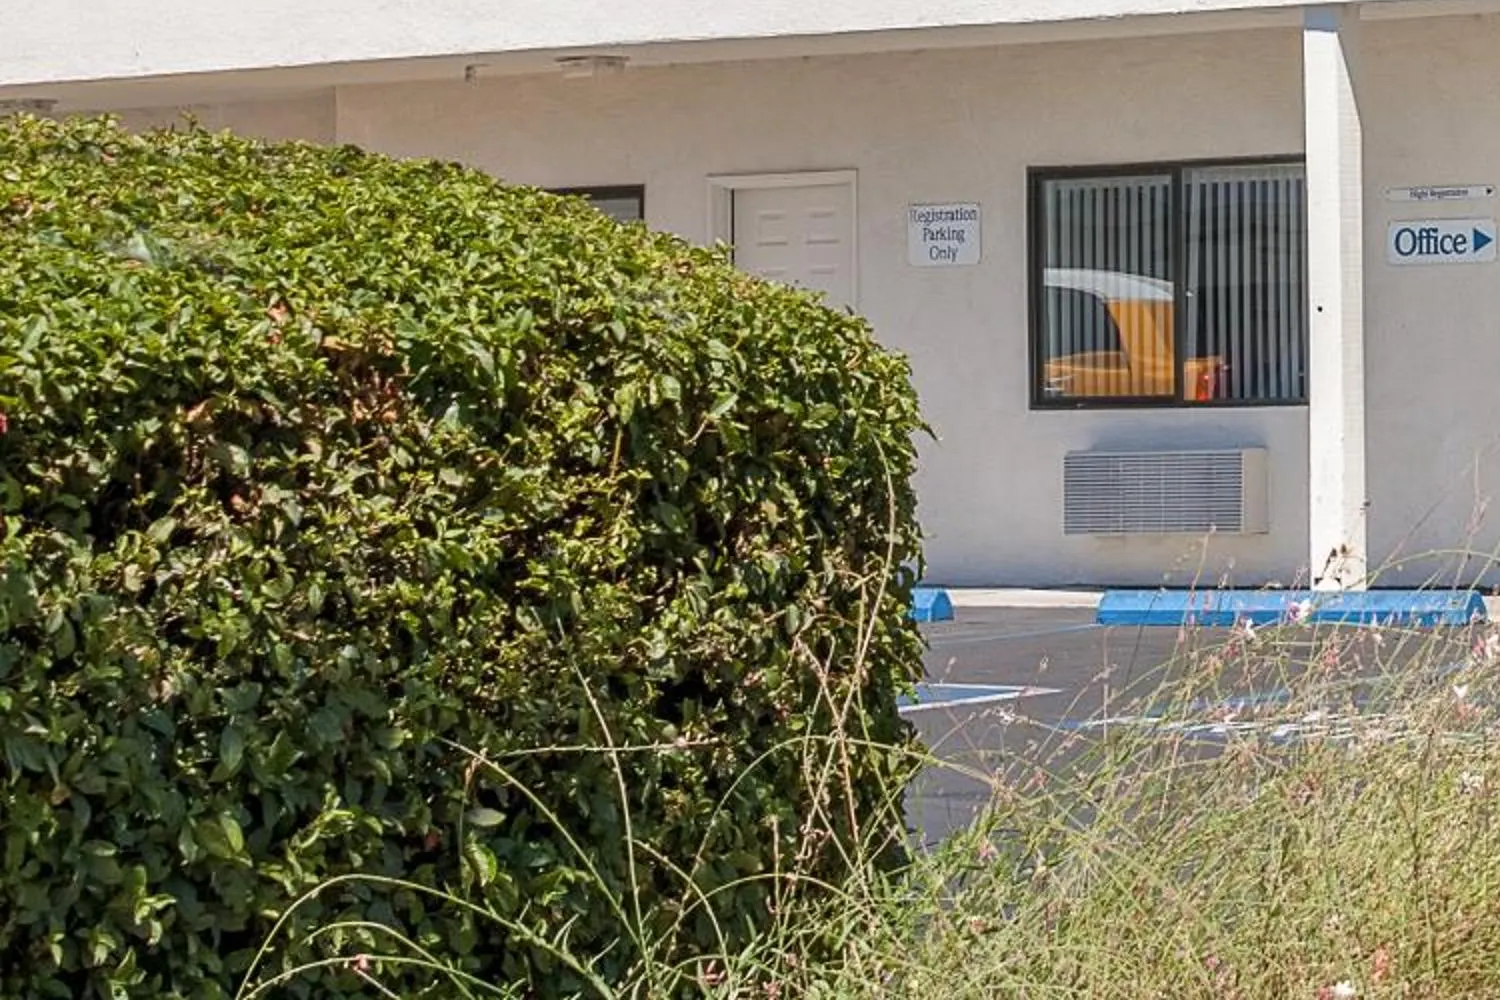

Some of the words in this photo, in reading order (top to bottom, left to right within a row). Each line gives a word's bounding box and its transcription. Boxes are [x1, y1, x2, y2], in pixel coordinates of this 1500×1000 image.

[909, 207, 977, 226] Registration
[923, 226, 965, 244] Parking
[1394, 227, 1468, 257] Office
[929, 245, 958, 263] Only
